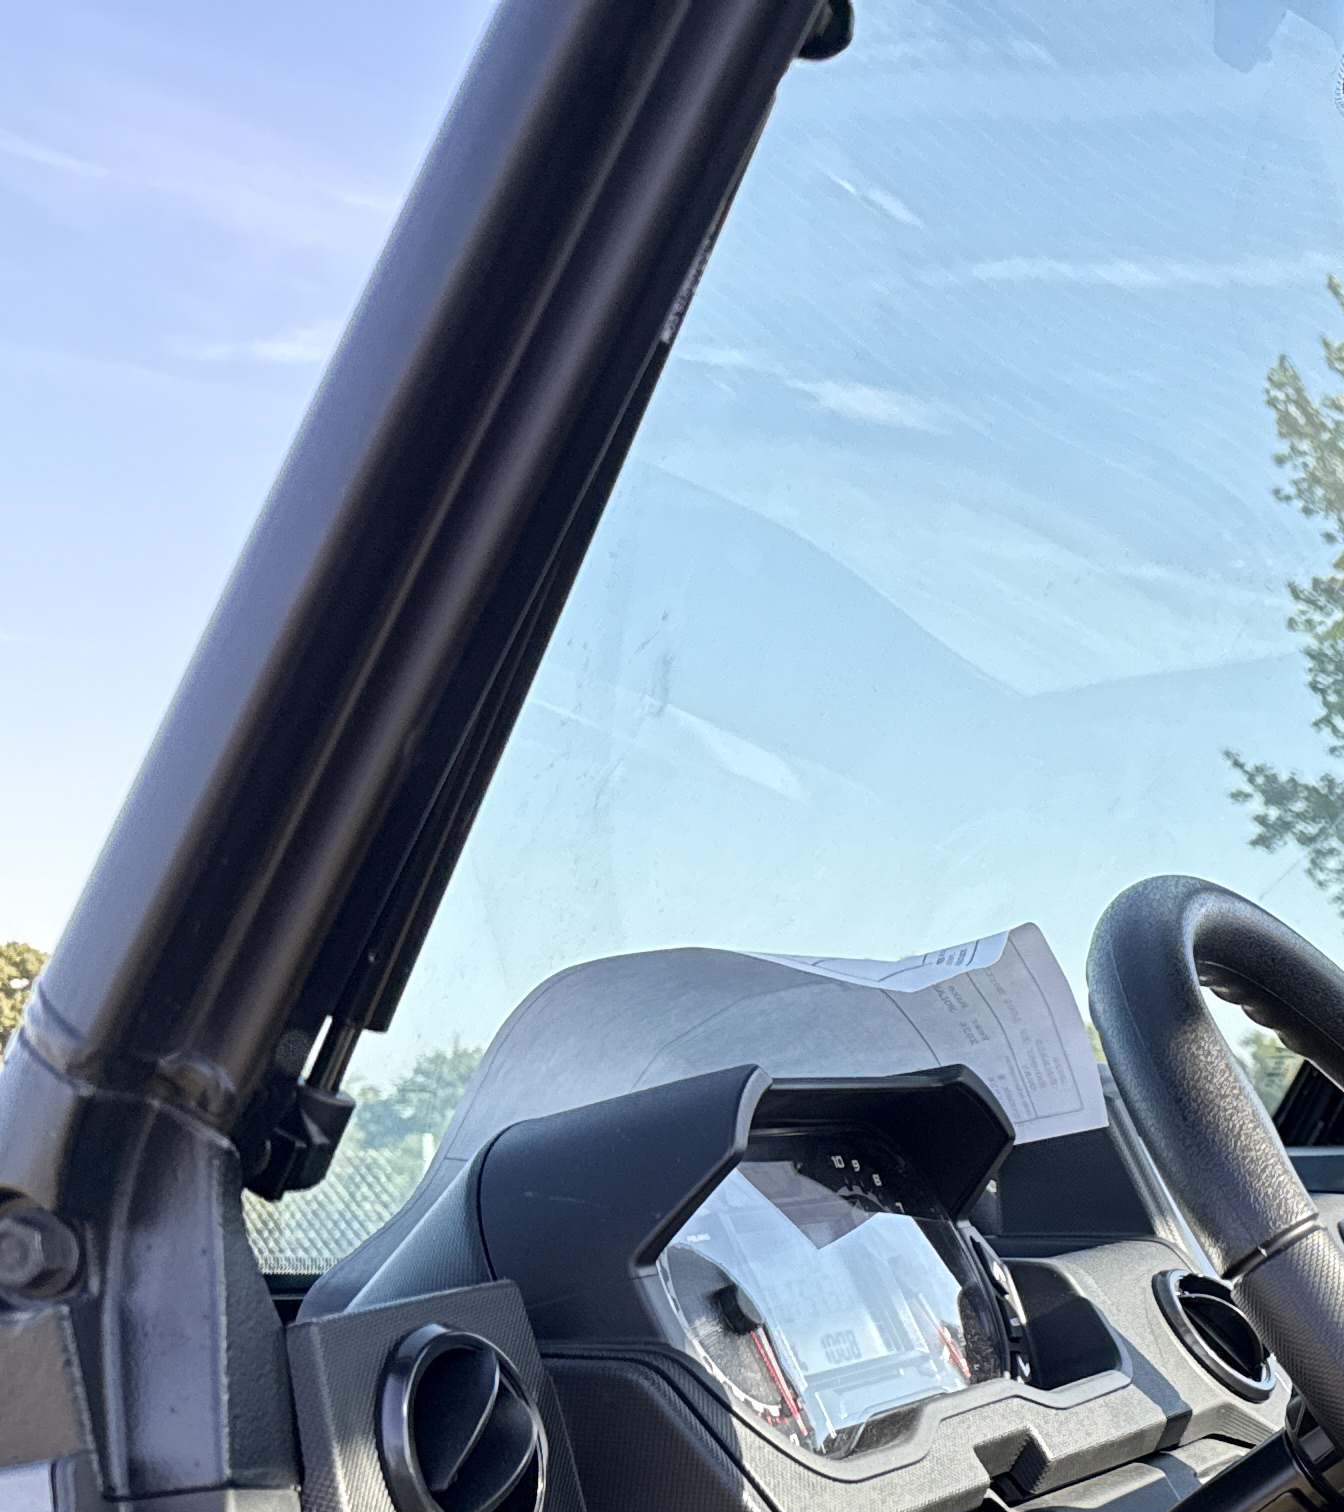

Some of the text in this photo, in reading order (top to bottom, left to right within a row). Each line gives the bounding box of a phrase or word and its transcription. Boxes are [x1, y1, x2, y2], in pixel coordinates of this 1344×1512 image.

[831, 1155, 845, 1168] 10
[852, 1160, 860, 1172] 9
[872, 1173, 882, 1187] 8
